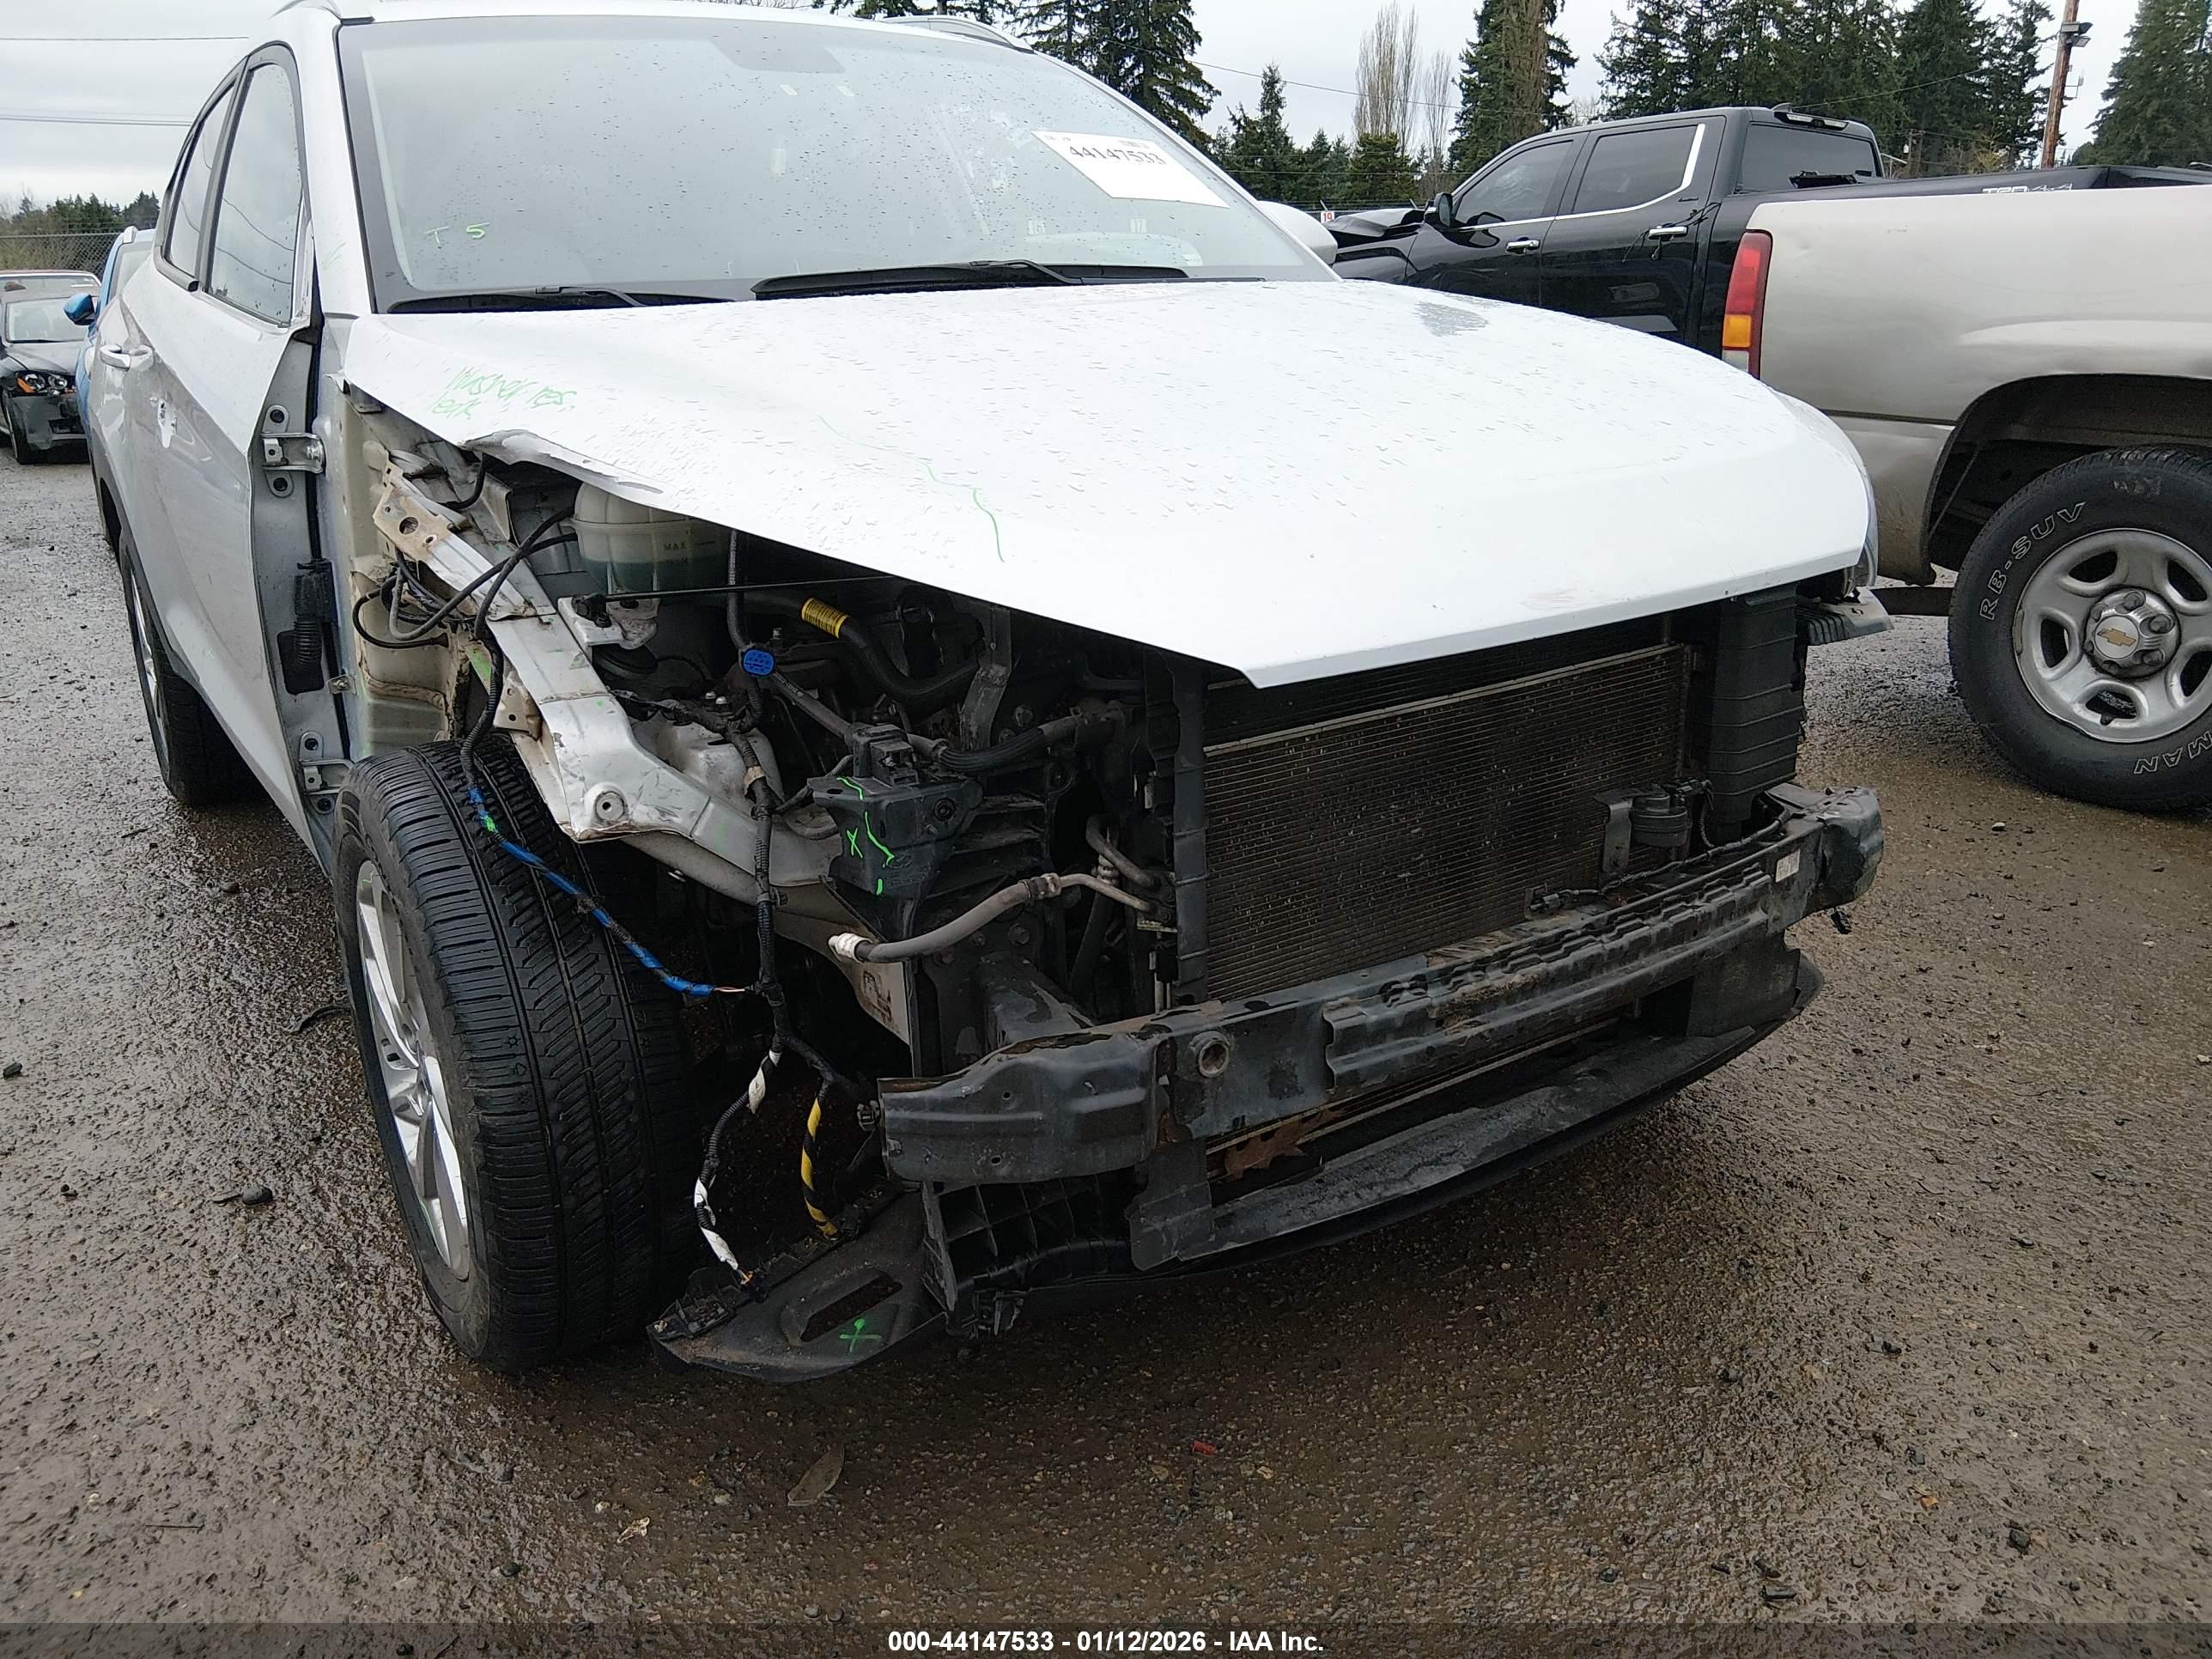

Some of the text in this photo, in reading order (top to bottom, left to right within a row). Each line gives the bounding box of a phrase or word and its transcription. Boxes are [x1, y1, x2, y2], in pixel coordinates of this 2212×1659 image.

[1070, 146, 1165, 165] 44147533
[664, 542, 687, 551] MAX
[1979, 501, 2087, 621] RB-SUV
